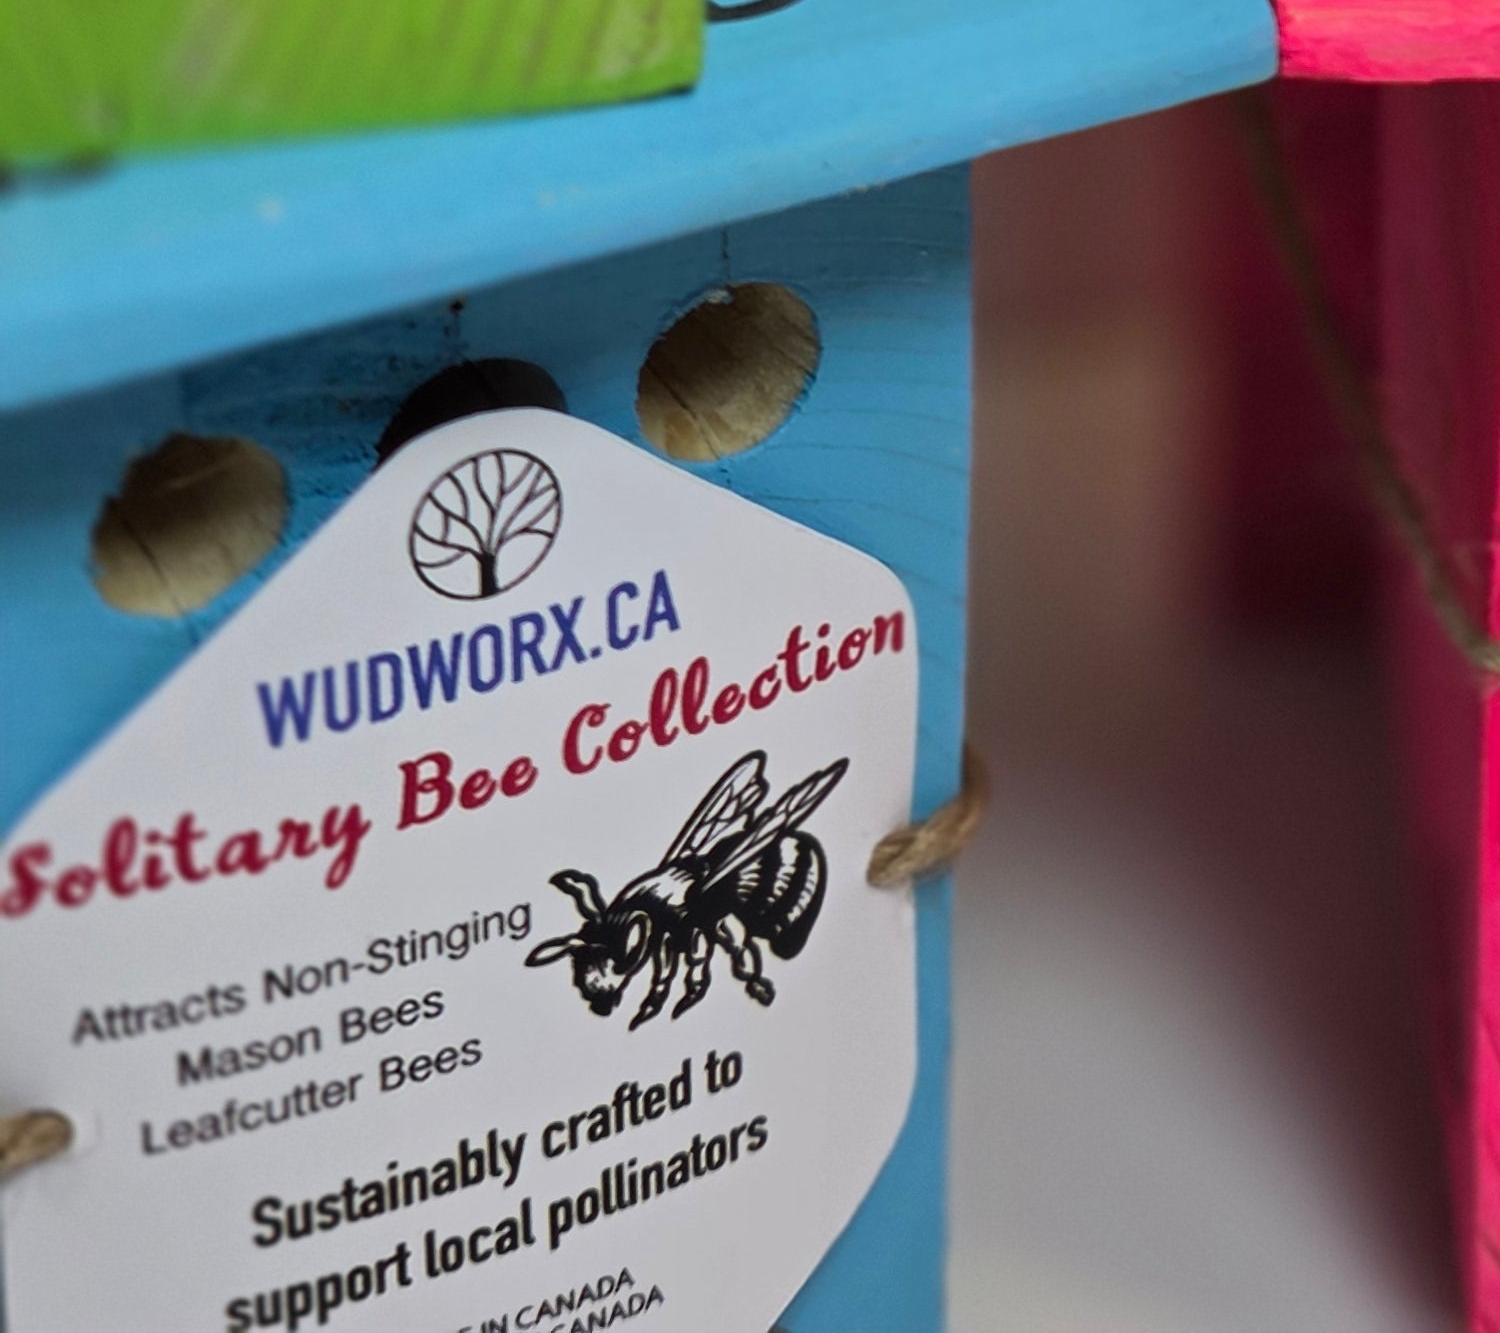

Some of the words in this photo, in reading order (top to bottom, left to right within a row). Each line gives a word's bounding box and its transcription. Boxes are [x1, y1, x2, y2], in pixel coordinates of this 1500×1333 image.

[256, 569, 682, 749] WUDWORX.CA
[0, 803, 371, 919] Solitary
[396, 750, 539, 830] Bee
[561, 608, 906, 778] Collection
[70, 984, 246, 1047] Attracts
[262, 900, 532, 1002] Non-Stinging
[174, 1024, 322, 1088] Mason
[340, 986, 445, 1046] Bees
[141, 1073, 362, 1156] Leafcutter
[380, 1035, 484, 1090] Bees
[251, 1125, 526, 1248] Sustainably
[541, 1057, 693, 1160] crafted
[705, 1046, 744, 1091] to
[225, 1239, 412, 1333] support
[424, 1199, 536, 1280] local
[549, 1113, 769, 1251] pollinators
[516, 1267, 636, 1331] CANADA
